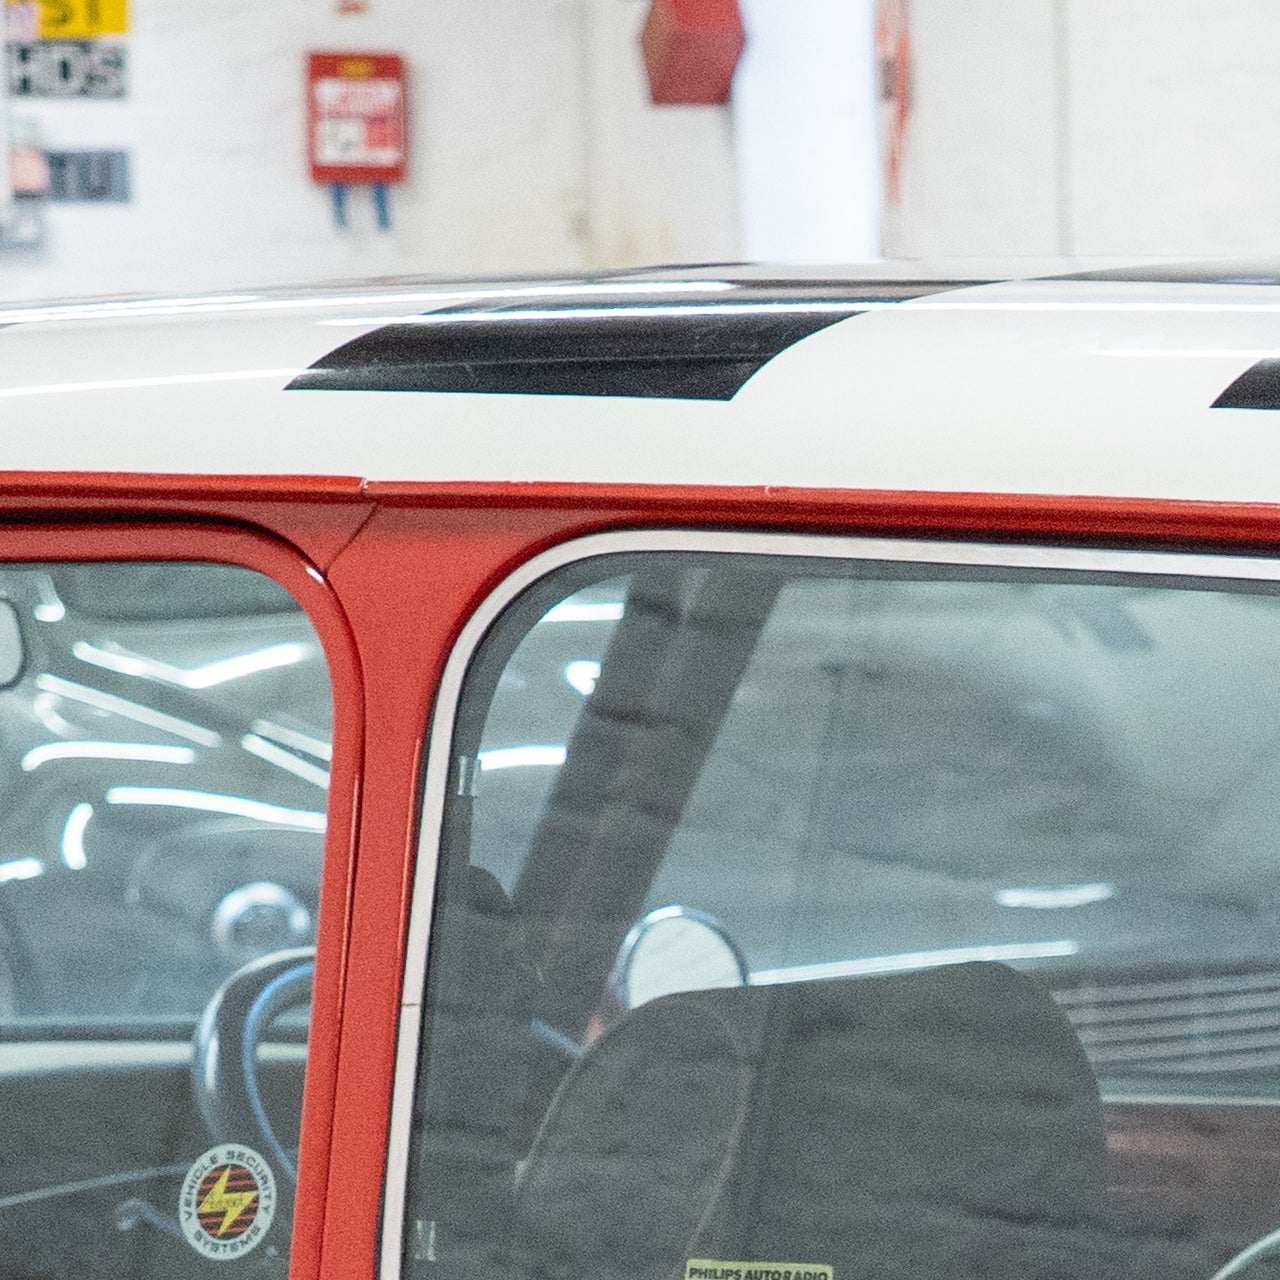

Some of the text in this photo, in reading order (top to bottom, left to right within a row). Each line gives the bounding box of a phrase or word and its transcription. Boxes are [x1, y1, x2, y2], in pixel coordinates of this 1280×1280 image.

[183, 1150, 272, 1221] VEHICLE SECURITY
[193, 1225, 260, 1253] SYSTEMS
[688, 1267, 742, 1280] PHILIPS
